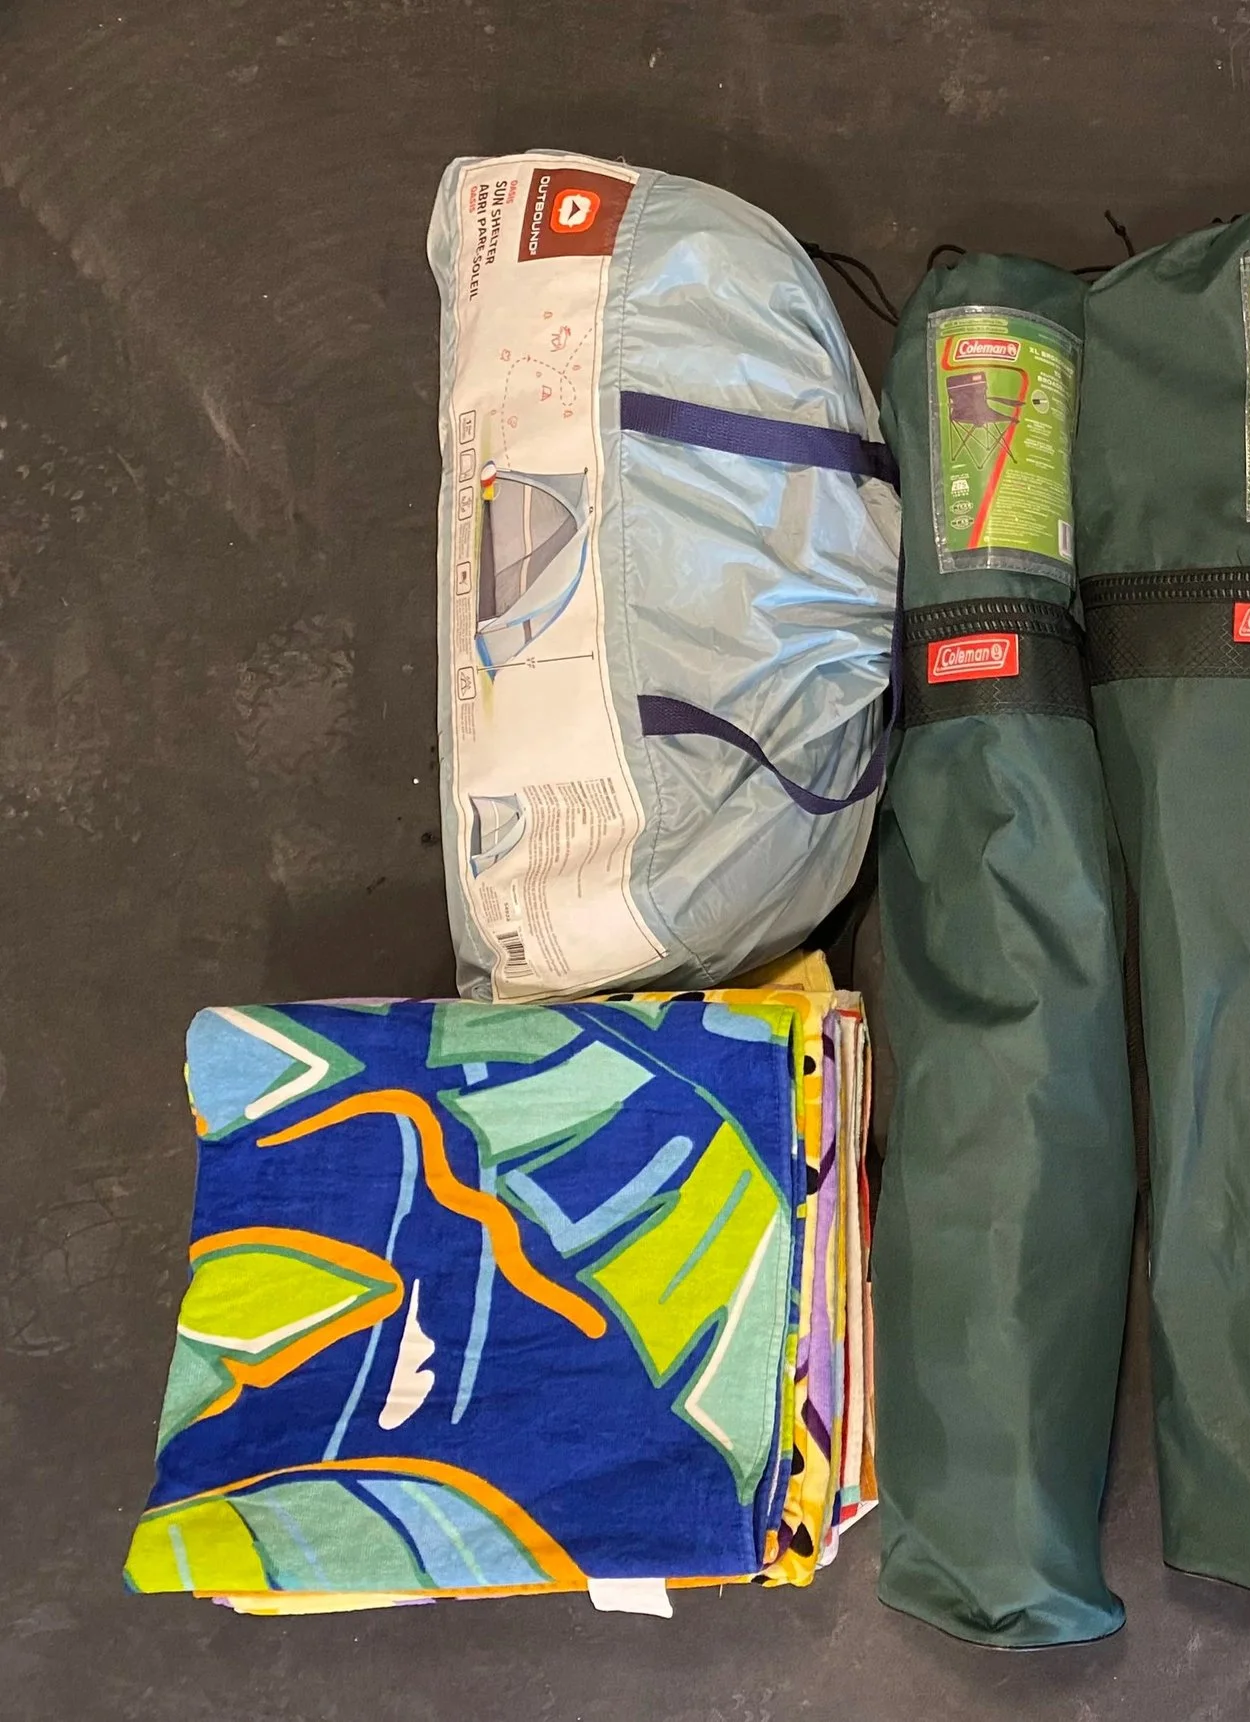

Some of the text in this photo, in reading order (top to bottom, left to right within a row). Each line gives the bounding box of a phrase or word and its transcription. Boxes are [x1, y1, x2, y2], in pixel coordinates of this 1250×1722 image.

[469, 184, 489, 302] ABRI PARE-SOLEIL
[485, 181, 507, 265] SUN SHELTER
[528, 176, 551, 252] OUTBOUND
[959, 341, 1007, 356] Coleman
[941, 647, 990, 667] Coleman
